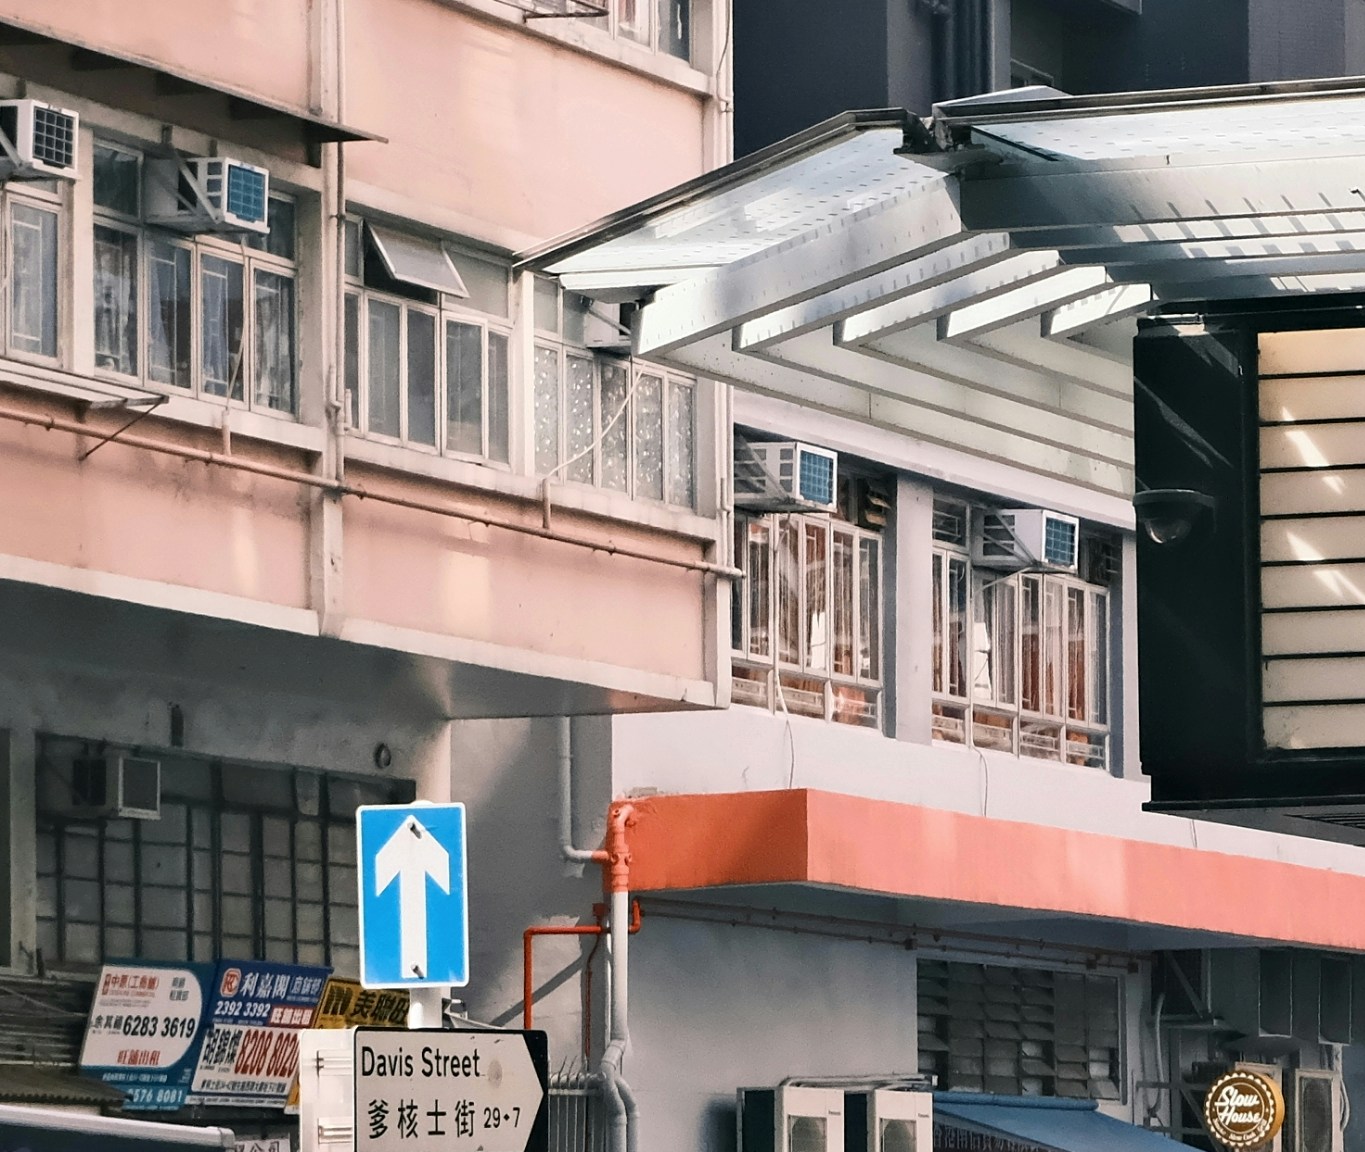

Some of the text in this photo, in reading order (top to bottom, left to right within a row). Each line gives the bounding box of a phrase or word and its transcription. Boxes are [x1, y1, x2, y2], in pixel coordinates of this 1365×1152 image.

[240, 971, 291, 1000] 利嘉閣
[214, 1000, 271, 1018] 2392 3392
[123, 1014, 159, 1037] 6283
[161, 1016, 195, 1038] 3619
[234, 1029, 273, 1076] 8208
[361, 1046, 480, 1077] Davis Street
[156, 1088, 183, 1104] 8081
[1214, 1085, 1260, 1107] Slow
[368, 1099, 476, 1140] 爹核士街
[1219, 1106, 1262, 1125] House
